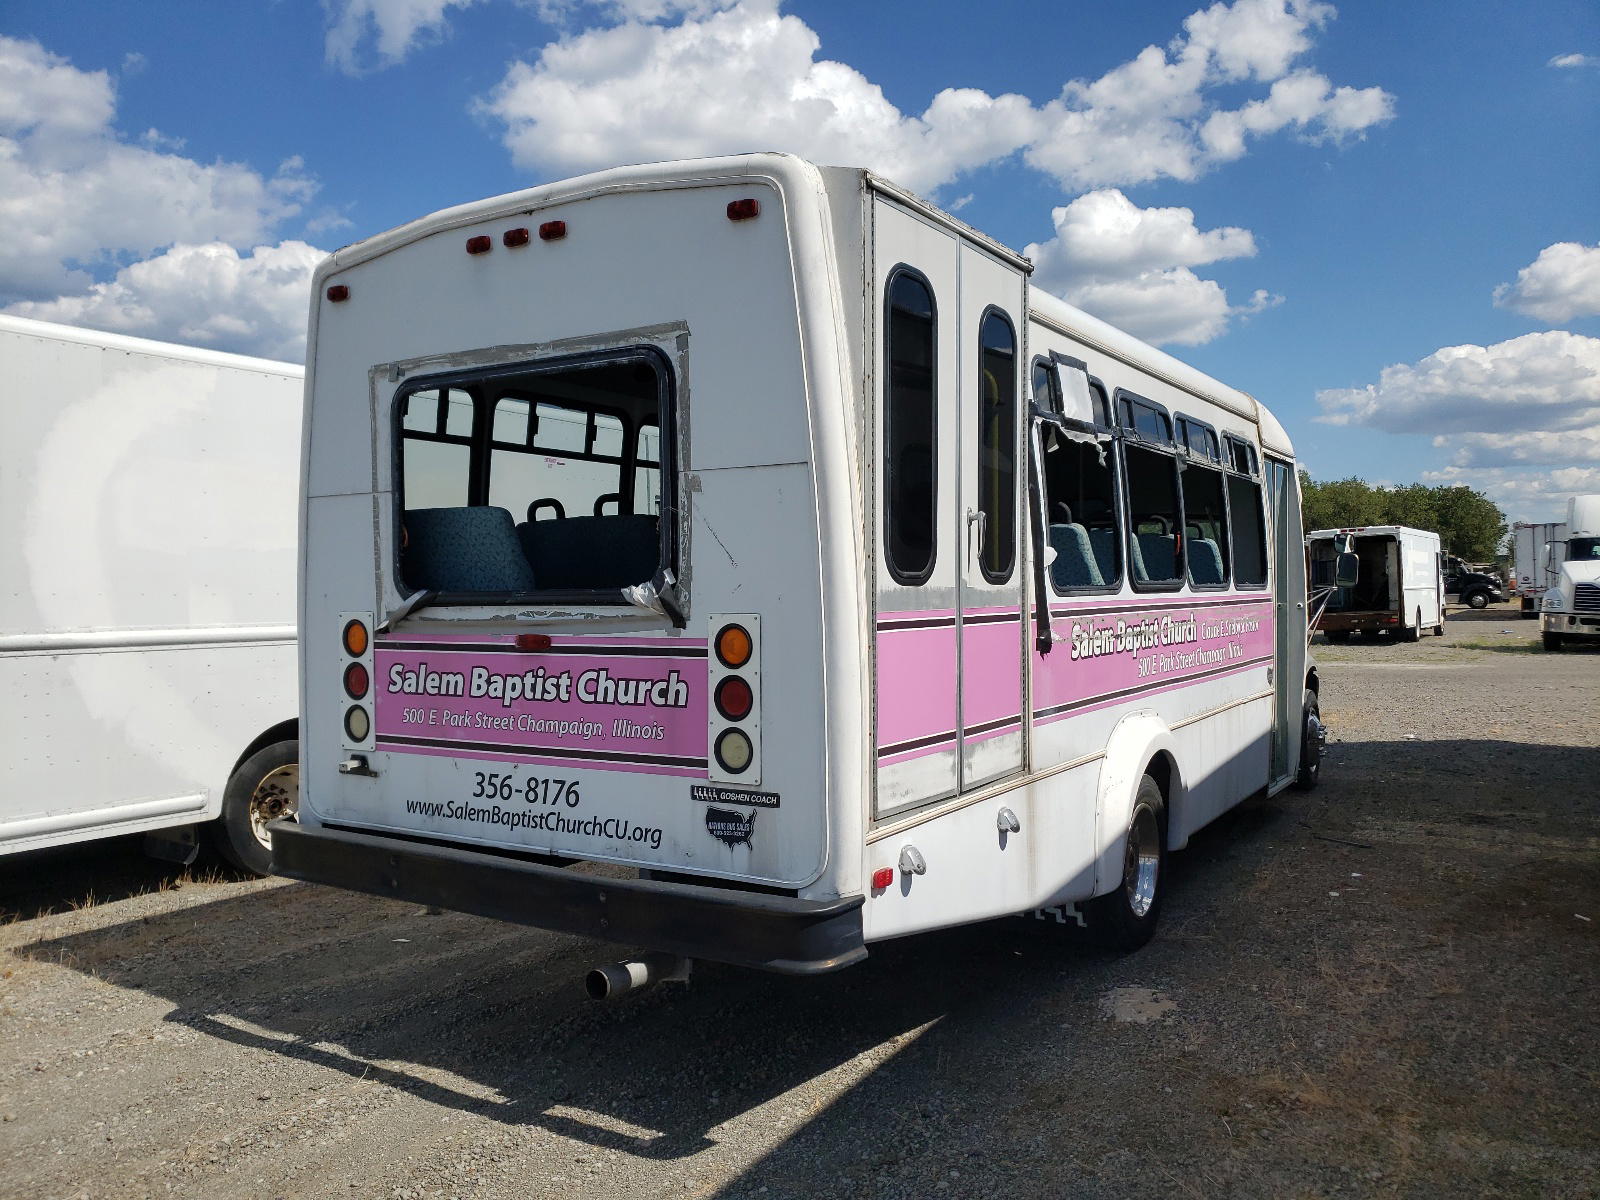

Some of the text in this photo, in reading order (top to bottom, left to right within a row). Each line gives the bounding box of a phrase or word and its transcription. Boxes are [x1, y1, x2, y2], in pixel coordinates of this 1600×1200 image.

[1071, 619, 1114, 661] Salem
[1116, 617, 1160, 659] Baptist
[1160, 613, 1198, 646] Church
[1159, 653, 1175, 673] Park
[1175, 650, 1196, 670] Street
[388, 662, 690, 708] Salem Baptist Church
[402, 708, 665, 740] 500 E. Park Street Champaign, Illinois
[472, 771, 580, 808] 356-8176
[720, 791, 778, 805] GOSHEN COACH
[406, 799, 663, 849] www.SalemBaptistChurchCU.org
